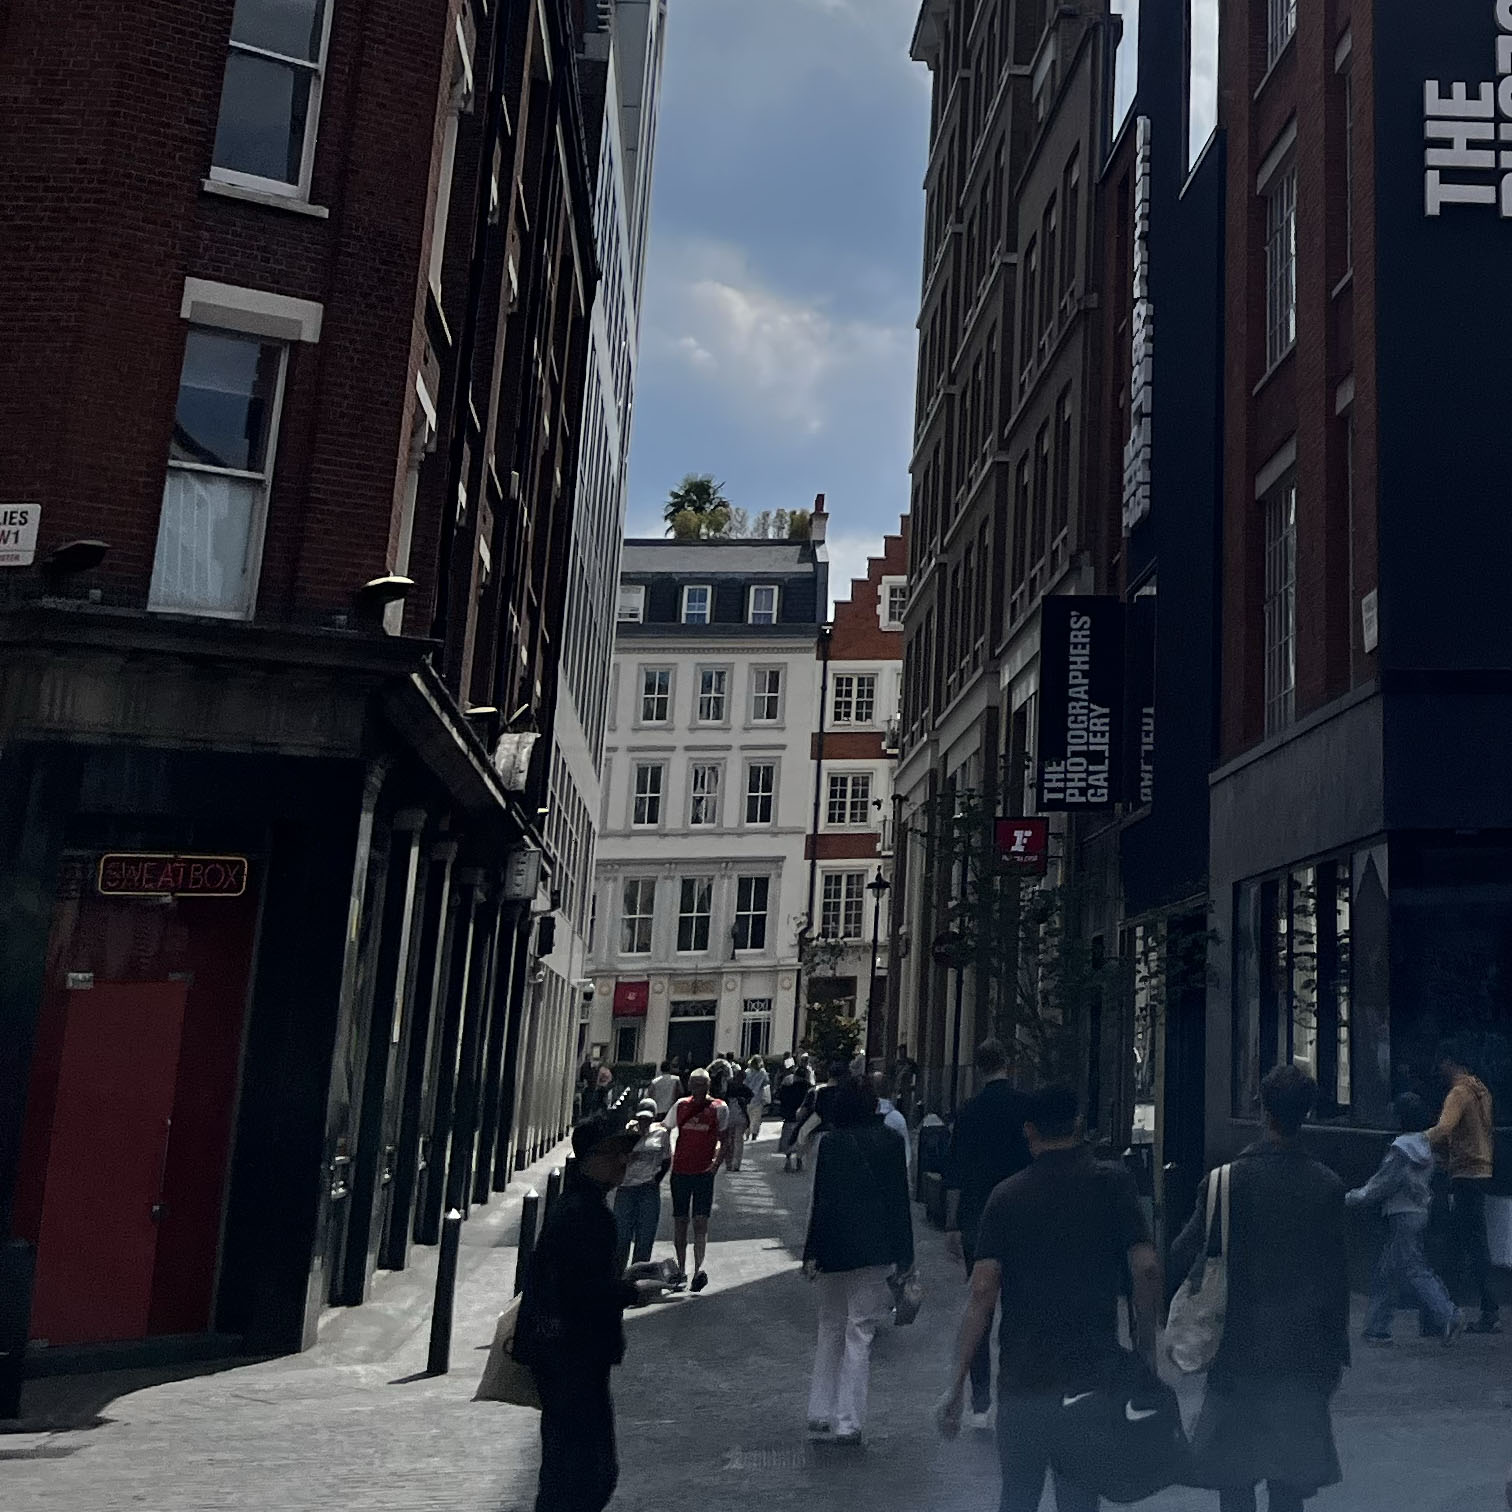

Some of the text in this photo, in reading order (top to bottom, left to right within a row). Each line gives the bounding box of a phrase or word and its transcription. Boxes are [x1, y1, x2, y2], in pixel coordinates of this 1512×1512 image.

[1423, 79, 1496, 217] THE
[0, 511, 29, 526] IES
[1087, 703, 1111, 804] GALLERY
[1043, 759, 1066, 803] THE
[104, 860, 241, 890] SWEATBOX
